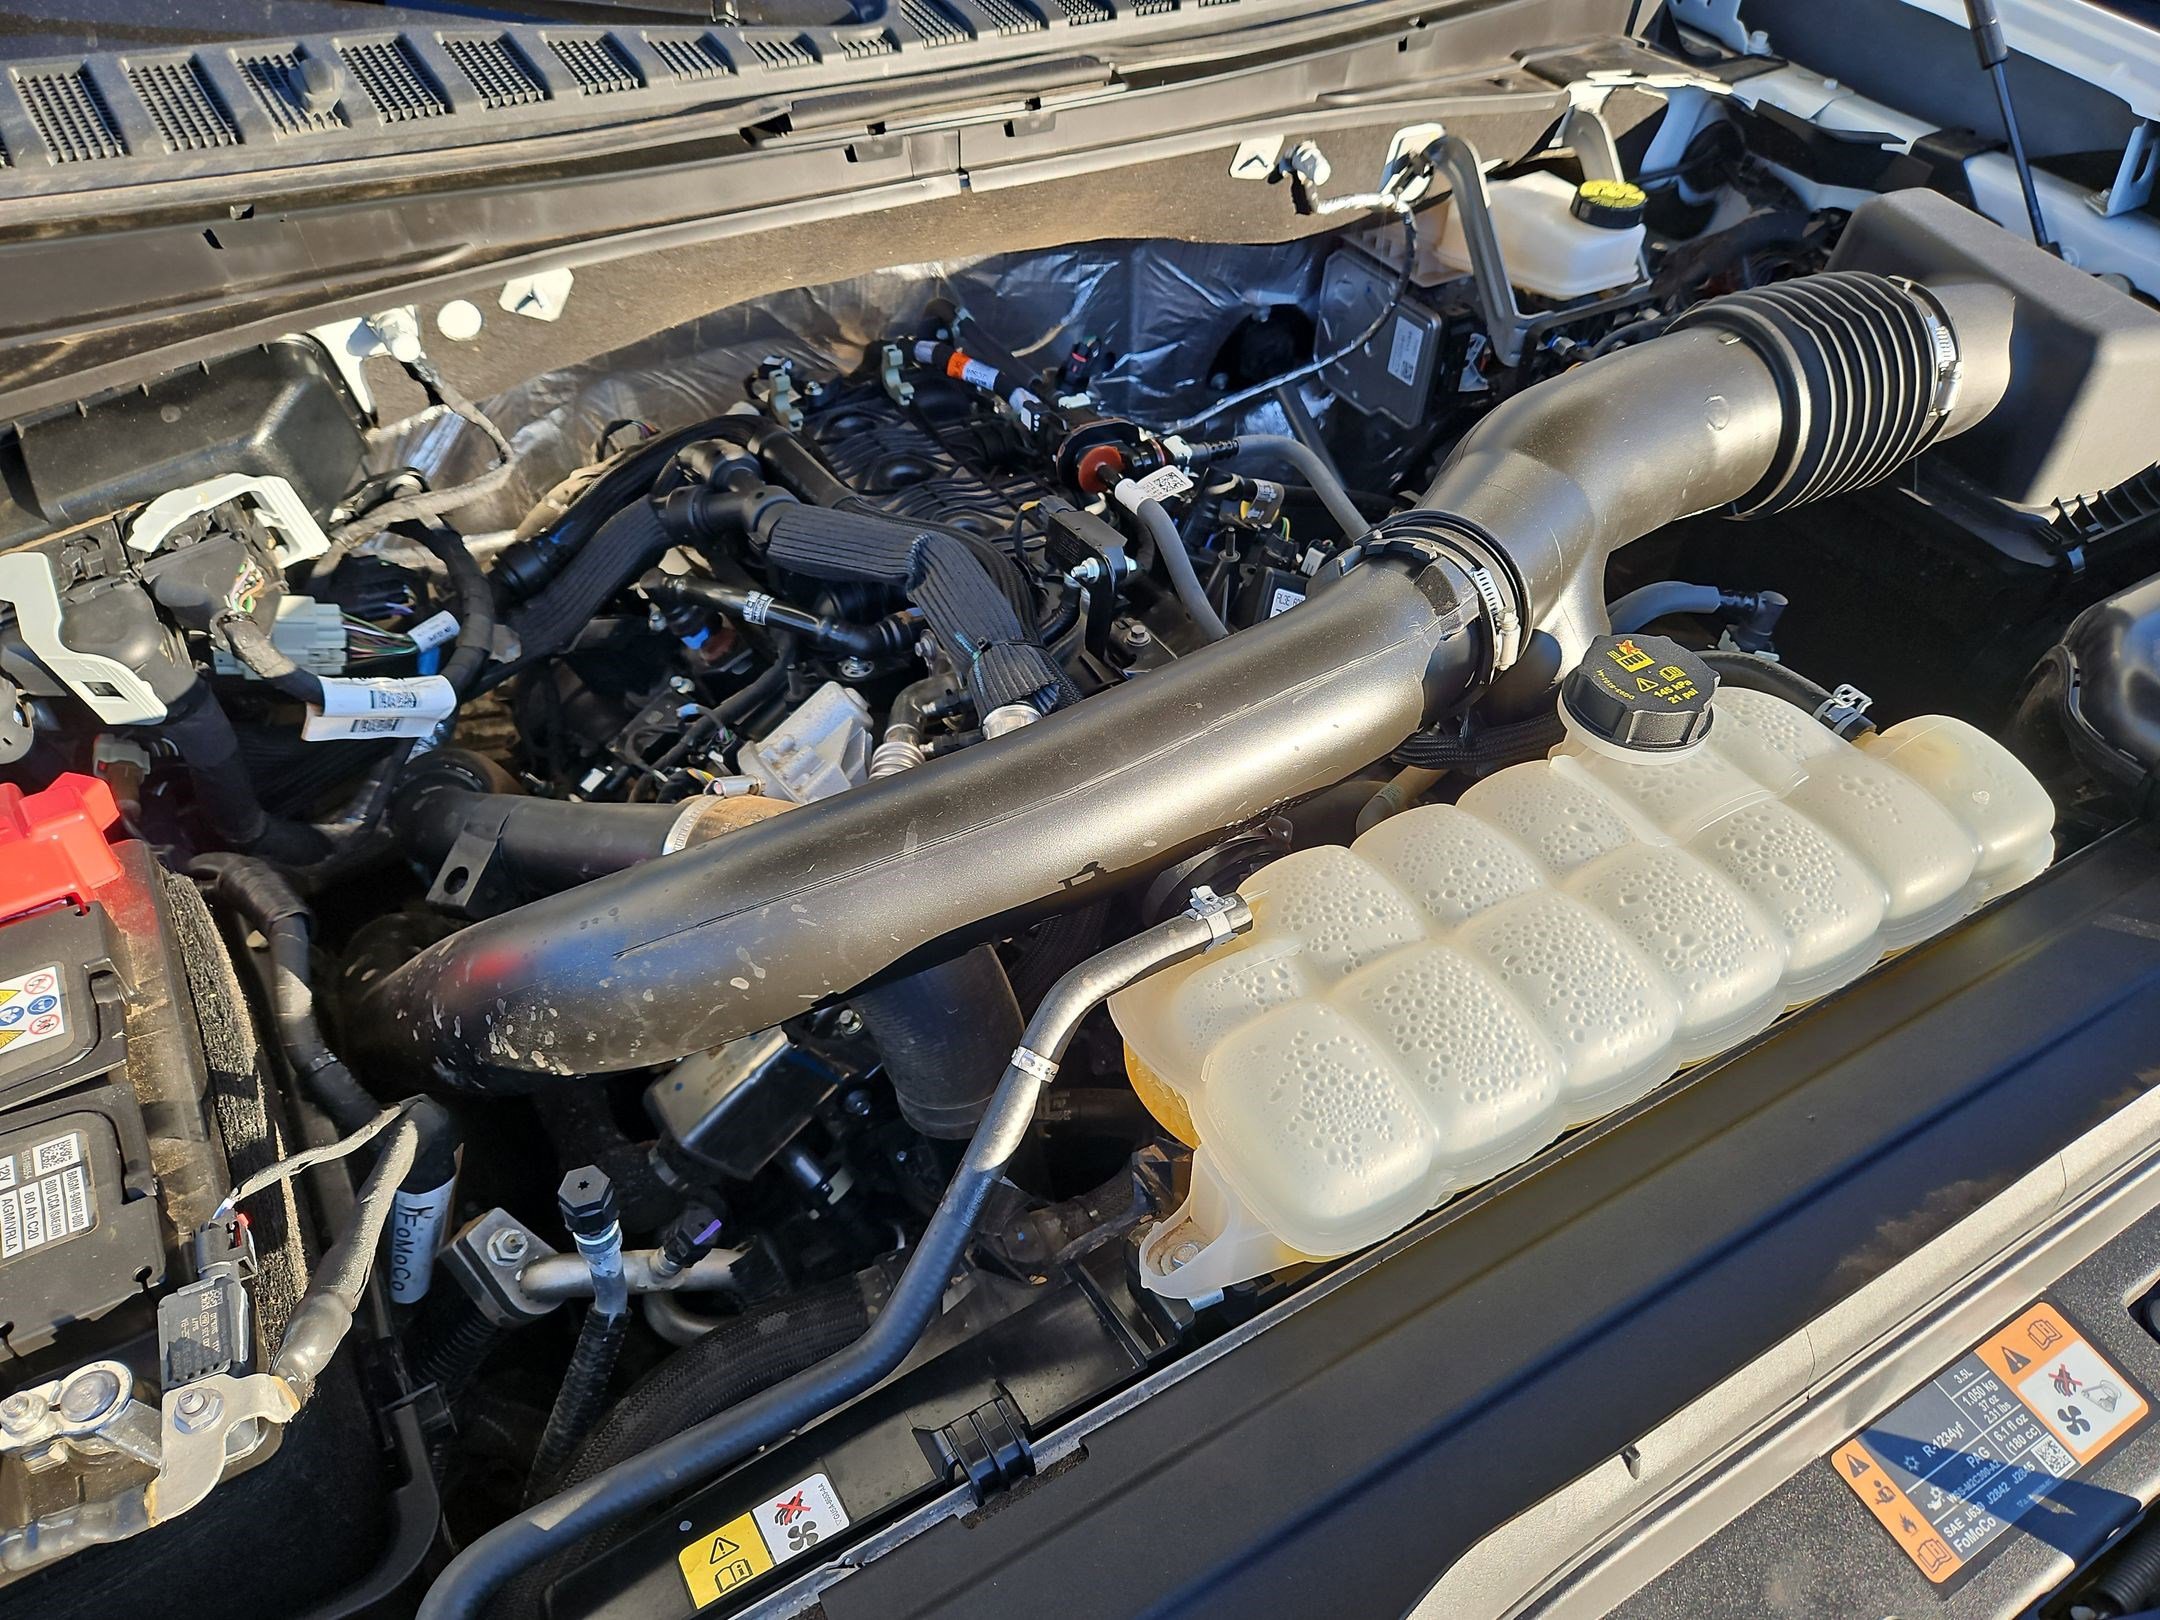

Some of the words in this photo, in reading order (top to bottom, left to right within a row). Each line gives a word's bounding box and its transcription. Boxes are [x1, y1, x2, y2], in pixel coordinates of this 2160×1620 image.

[1653, 684, 1675, 698] 145
[1673, 679, 1693, 692] kPa
[1667, 693, 1684, 704] 21
[1682, 688, 1699, 700] psi
[0, 1164, 11, 1181] 12V
[45, 1179, 58, 1195] 800
[24, 1191, 36, 1205] 80
[47, 1194, 60, 1212] CCA
[26, 1206, 38, 1220] Ah
[1, 1198, 17, 1252] AGM/VRLA
[27, 1220, 39, 1240] C20
[391, 1211, 417, 1292] FoMoCo
[1953, 1368, 1973, 1384] 3.5L
[1962, 1384, 1985, 1407] 1.050
[1983, 1379, 1999, 1392] kg
[1978, 1399, 1989, 1411] 37
[1988, 1394, 2000, 1406] oz
[1998, 1402, 2012, 1416] lbs
[1993, 1426, 2009, 1442] 6.1
[2016, 1413, 2029, 1425] oz
[1922, 1420, 1966, 1458] R-1234yf
[2005, 1438, 2025, 1456] (180
[2025, 1424, 2041, 1442] cc)
[1966, 1446, 1990, 1468] PAG
[1943, 1518, 1966, 1538] SAE
[1986, 1482, 2011, 1505] J2842
[2011, 1460, 2036, 1485] J2845
[1953, 1516, 1997, 1553] FoMoCo
